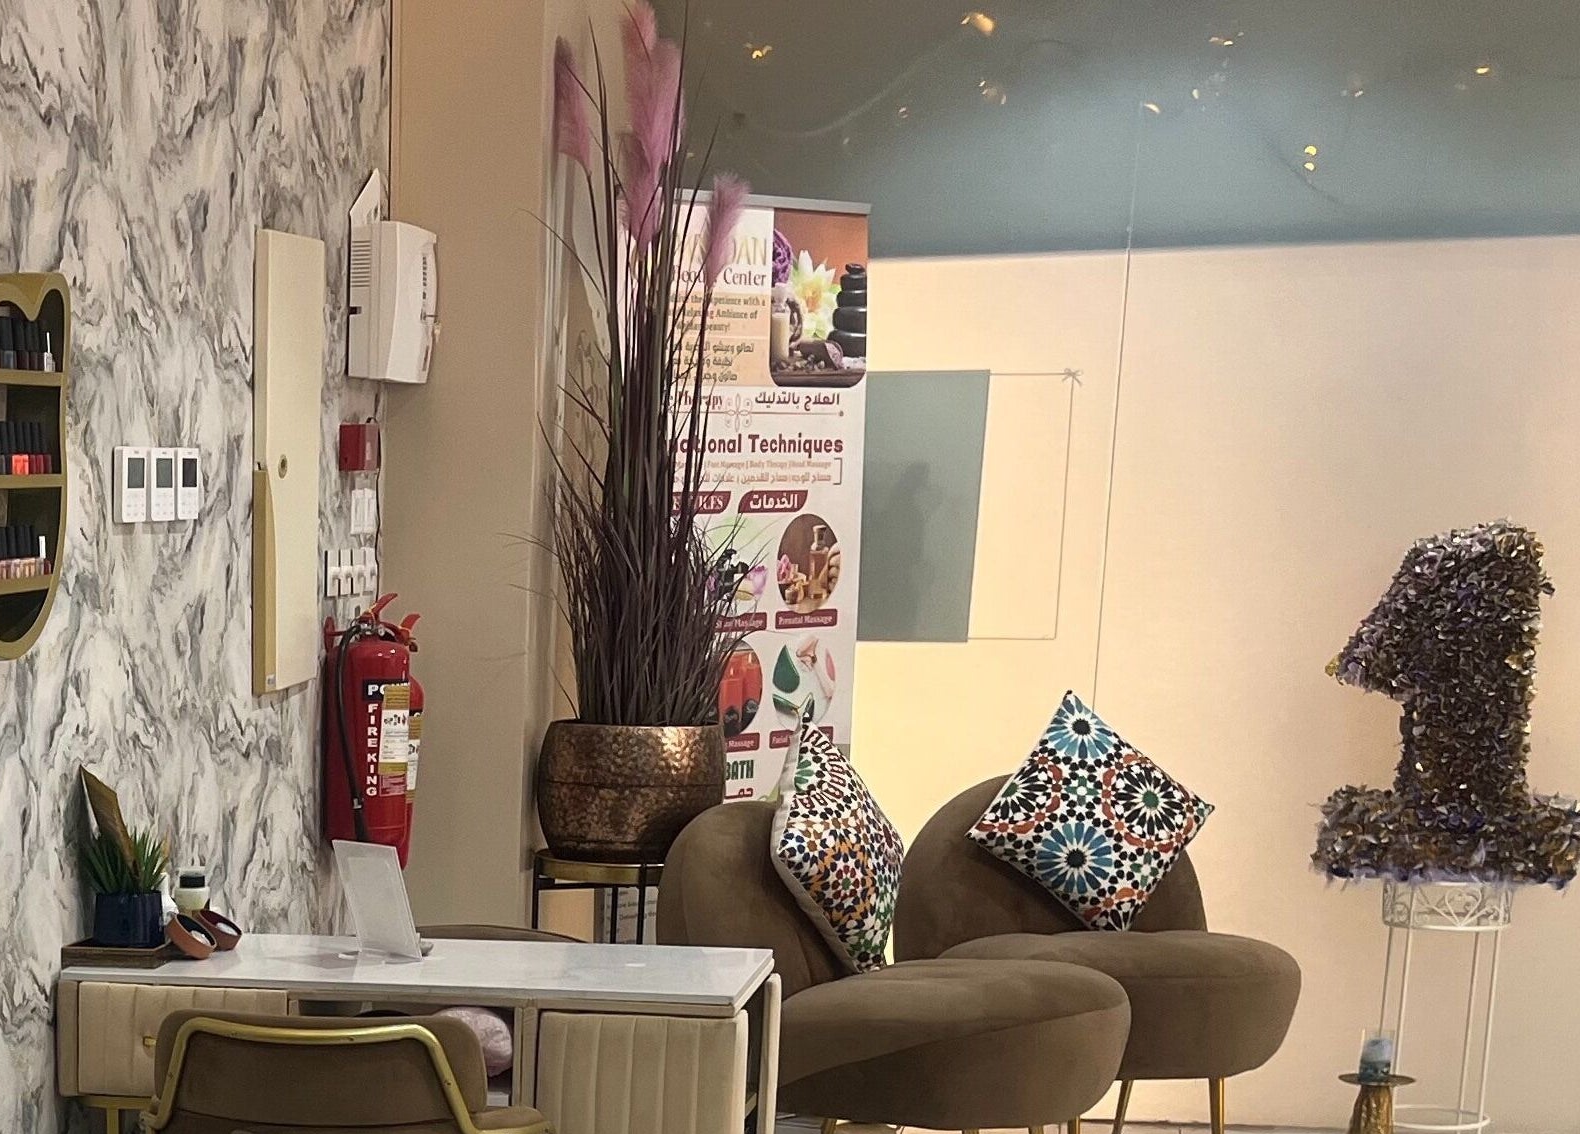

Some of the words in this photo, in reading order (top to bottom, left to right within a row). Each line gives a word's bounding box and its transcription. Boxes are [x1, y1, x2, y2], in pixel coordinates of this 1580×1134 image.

[723, 267, 767, 286] Center
[754, 391, 800, 409] بالتدليك
[804, 393, 840, 411] العلاج
[748, 432, 844, 459] Techniques
[749, 492, 798, 510] الخدمات
[804, 615, 833, 624] Massage
[367, 703, 379, 748] FIRE
[366, 752, 378, 797] KING
[725, 760, 754, 780] BATH
